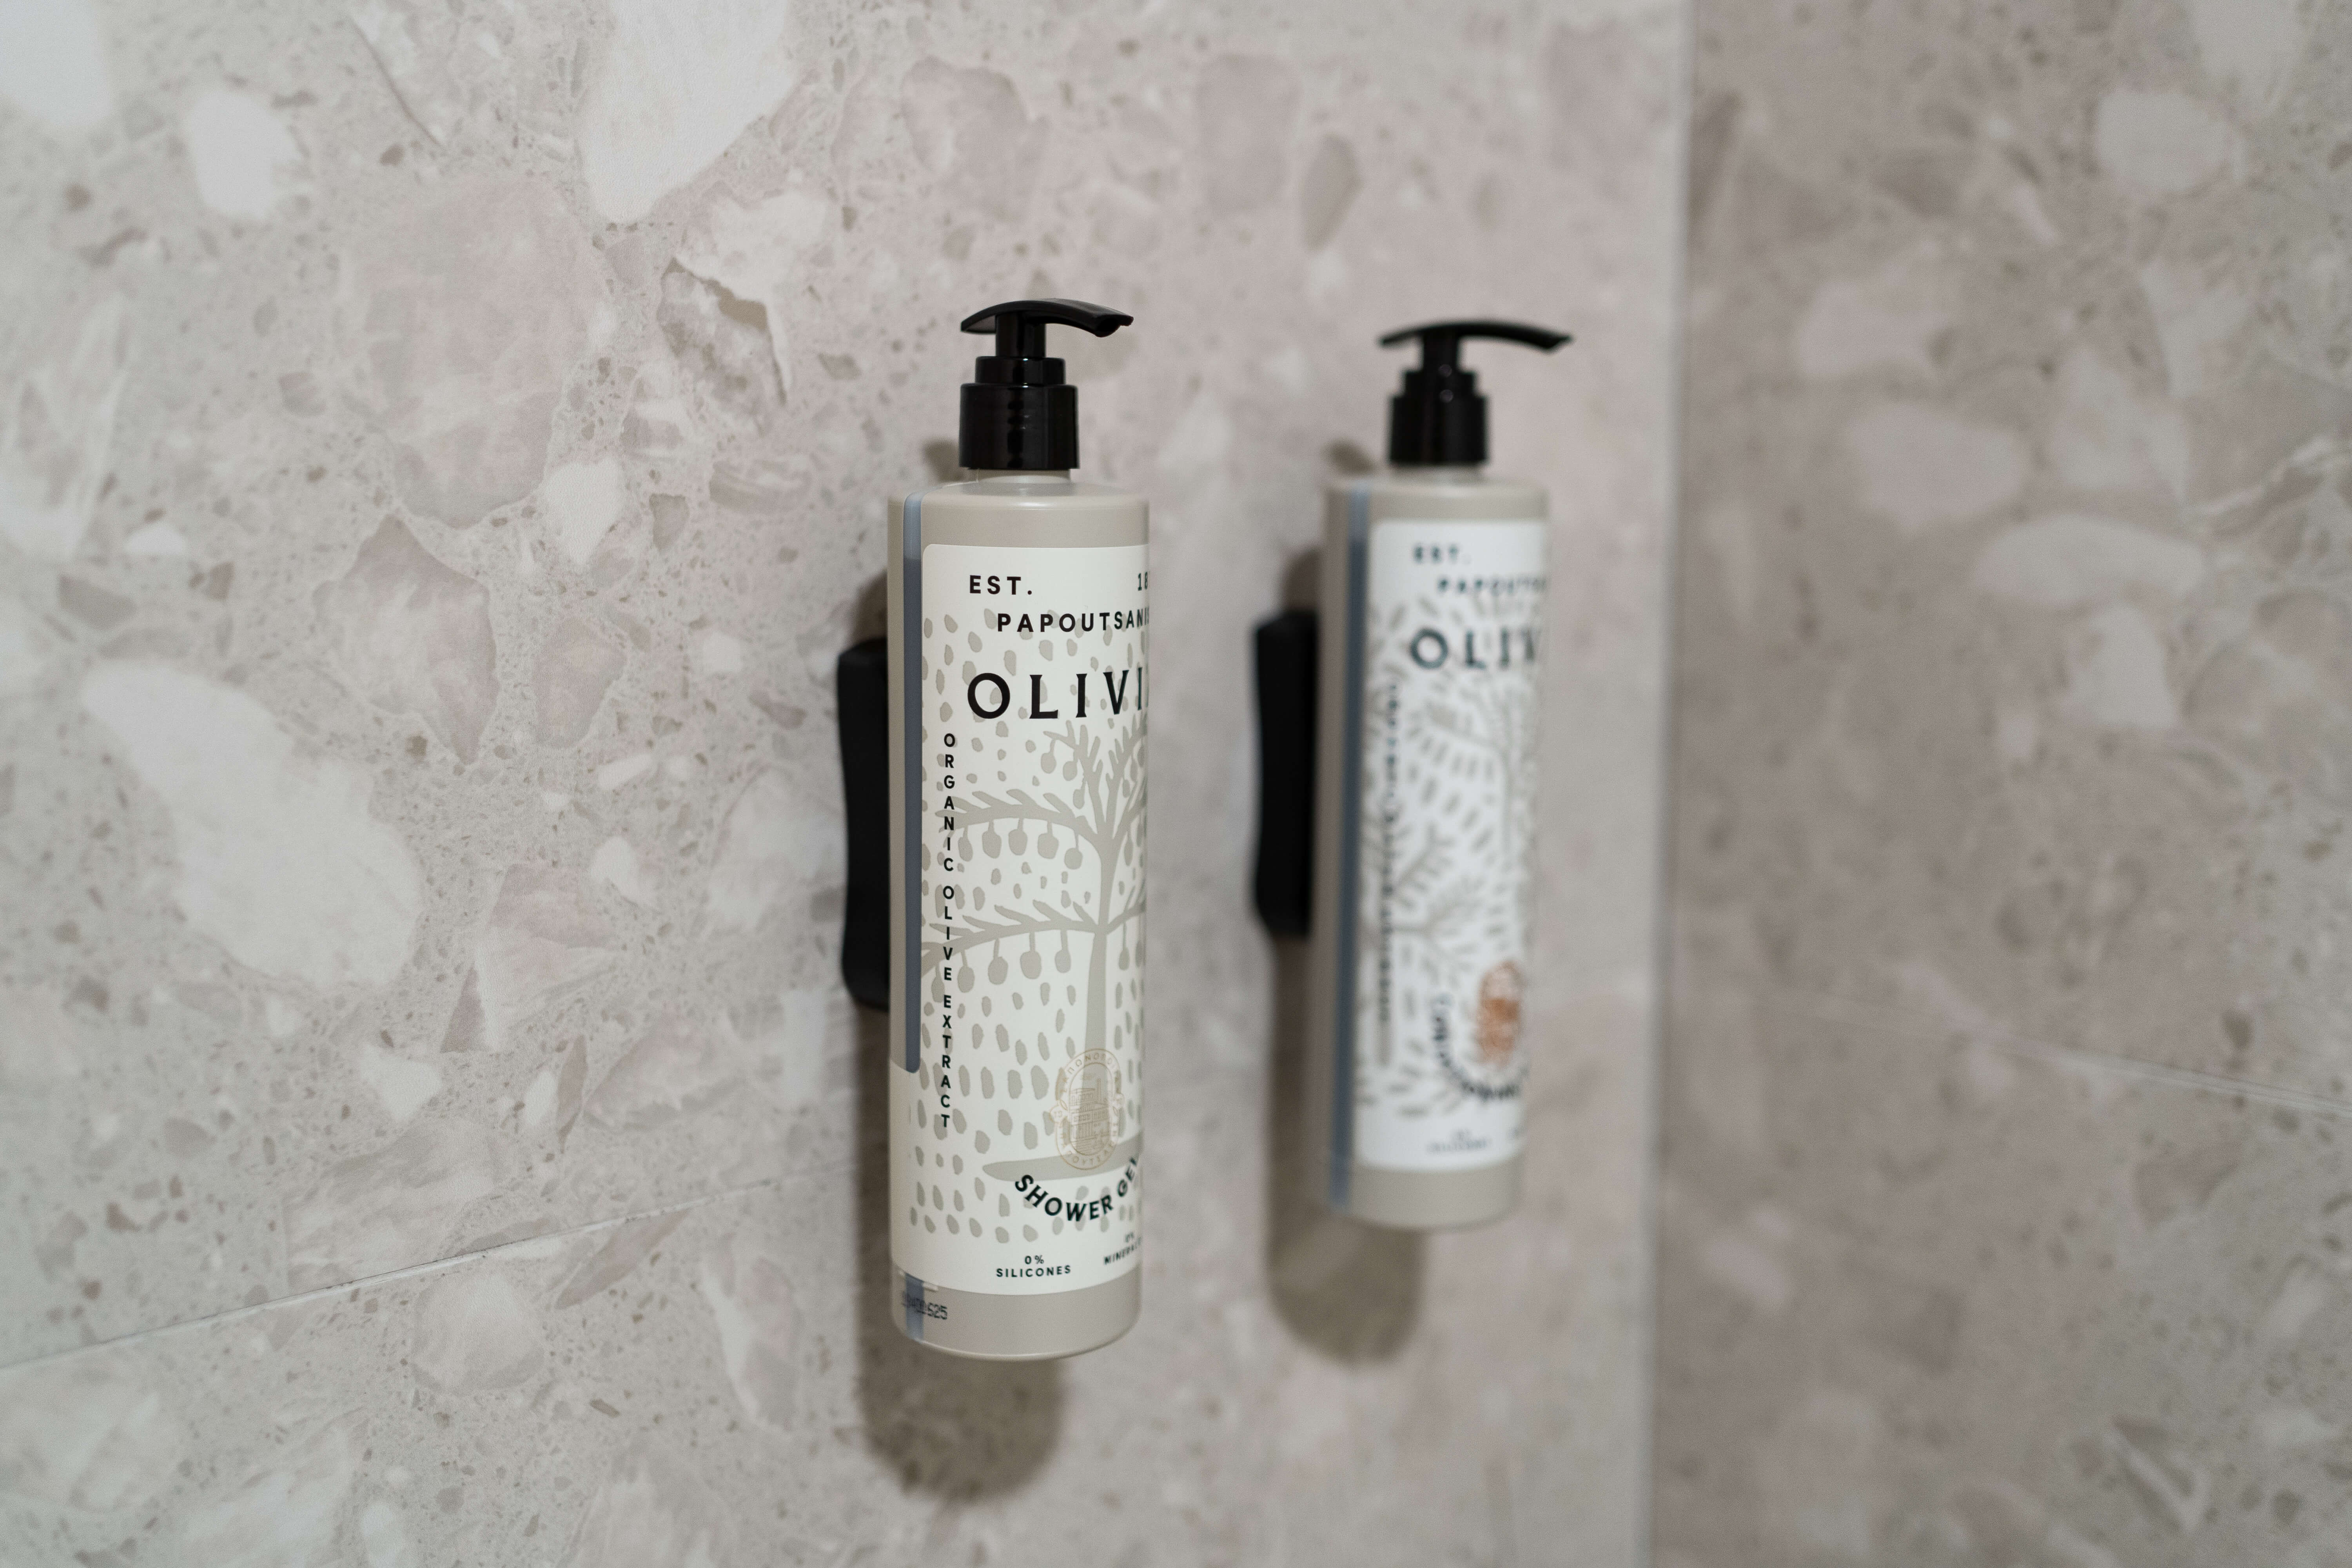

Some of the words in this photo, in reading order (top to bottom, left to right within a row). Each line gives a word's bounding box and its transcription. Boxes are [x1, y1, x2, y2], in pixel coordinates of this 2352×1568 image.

[969, 574, 1032, 595] EST.
[1138, 571, 1150, 591] 18
[967, 664, 1149, 719] OLIVI
[943, 733, 956, 872] ORGANIC
[942, 885, 955, 981] OLIVE
[940, 994, 953, 1128] EXTRACT
[1014, 1174, 1113, 1222] SHOWER
[996, 1265, 1071, 1278] SILICONES
[1024, 1255, 1045, 1265] 0%
